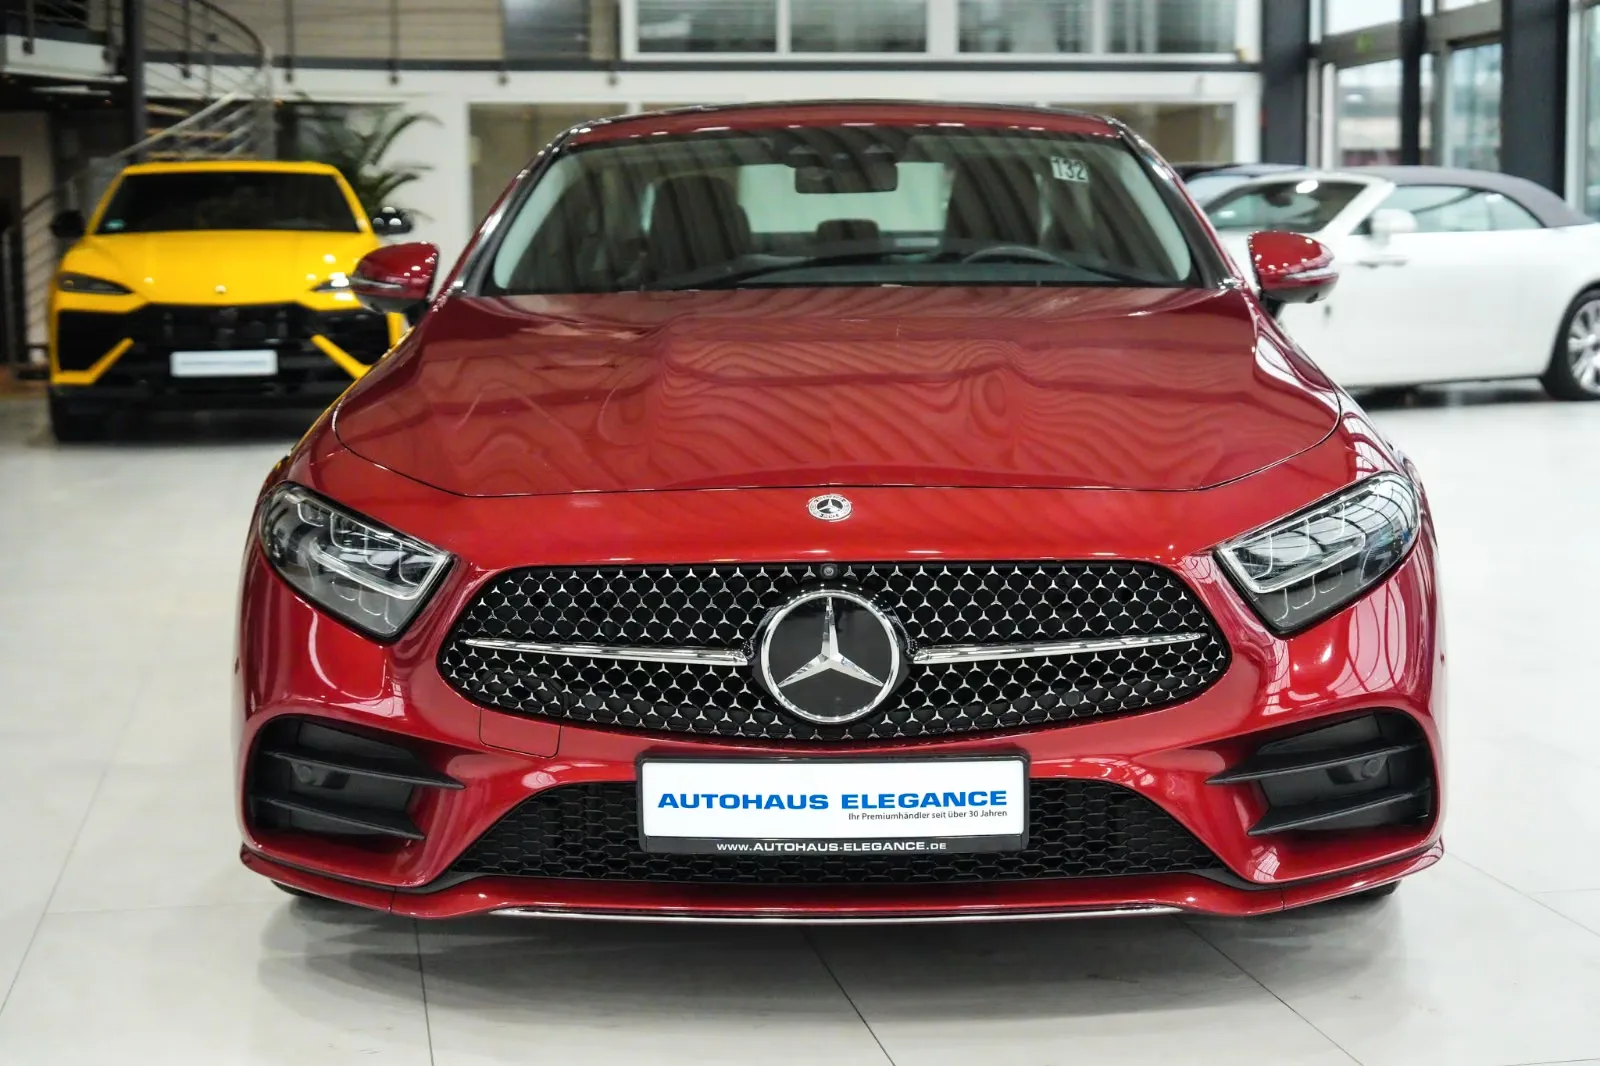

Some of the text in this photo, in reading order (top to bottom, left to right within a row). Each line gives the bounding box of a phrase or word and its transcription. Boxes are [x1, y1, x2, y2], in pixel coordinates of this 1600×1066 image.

[1053, 157, 1087, 181] 132
[657, 790, 1008, 810] AUTOHAUS ELEGANCE
[848, 809, 1008, 821] Ihr Premiumhändler seit über 30 Jahren
